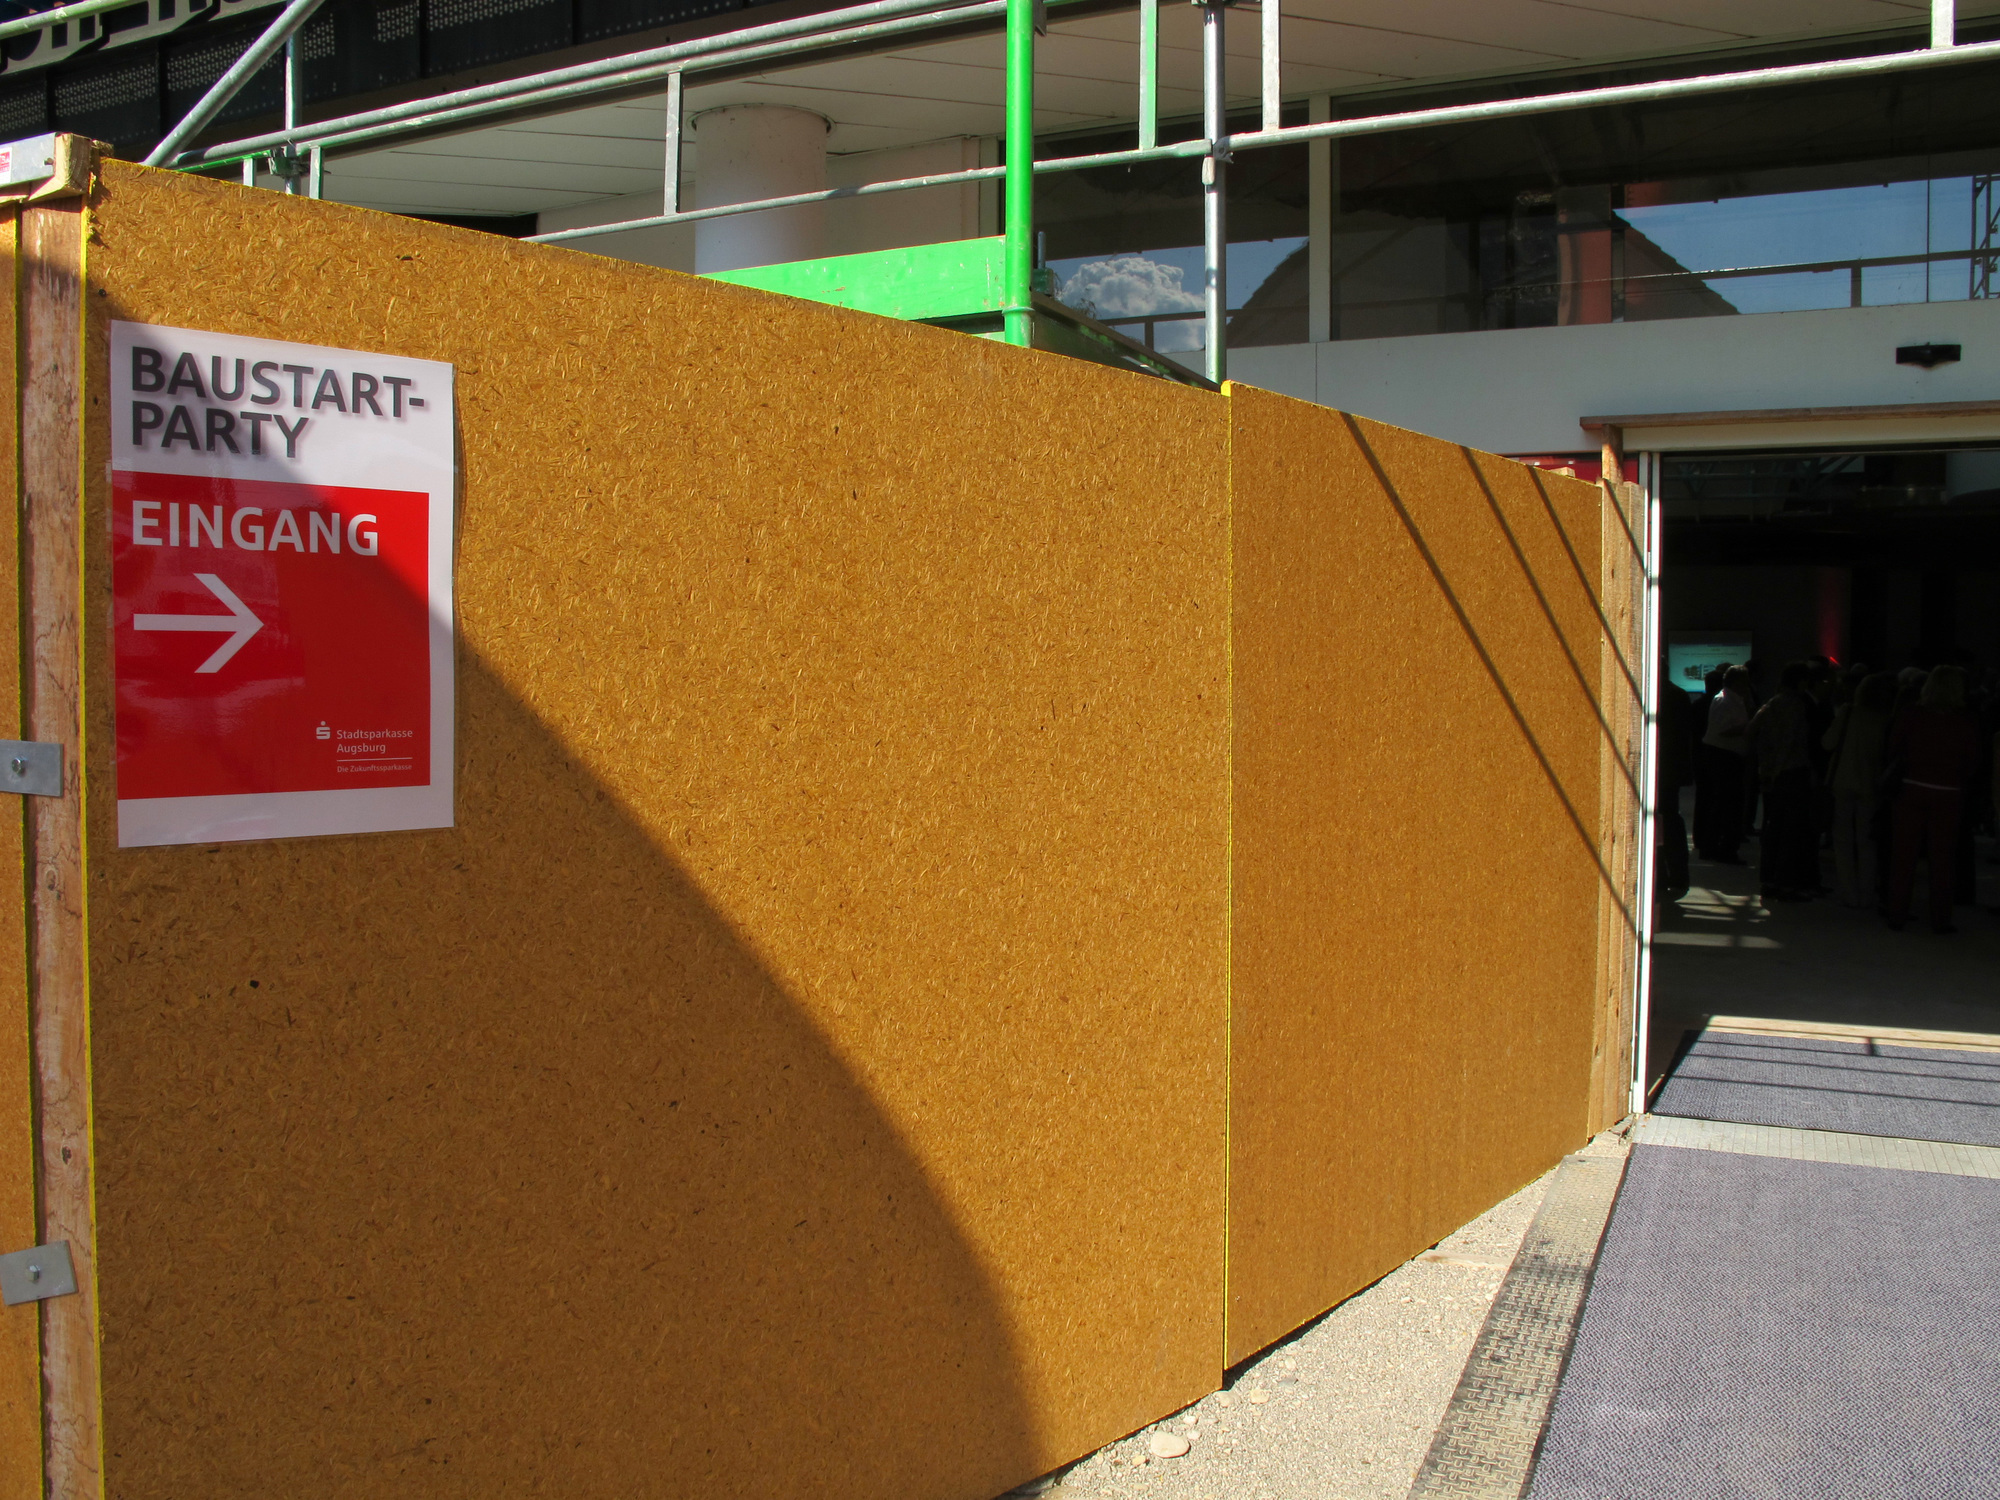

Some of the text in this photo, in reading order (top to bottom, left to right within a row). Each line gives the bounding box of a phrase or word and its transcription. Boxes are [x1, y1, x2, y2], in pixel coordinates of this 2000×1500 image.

[132, 347, 425, 418] BAUSTART-
[132, 401, 309, 458] PARTY
[132, 500, 379, 556] EINGANG
[336, 729, 413, 740] Stadtsparkasse
[336, 743, 386, 755] Augsburg
[337, 764, 413, 773] Die Zukunftssparkasse
